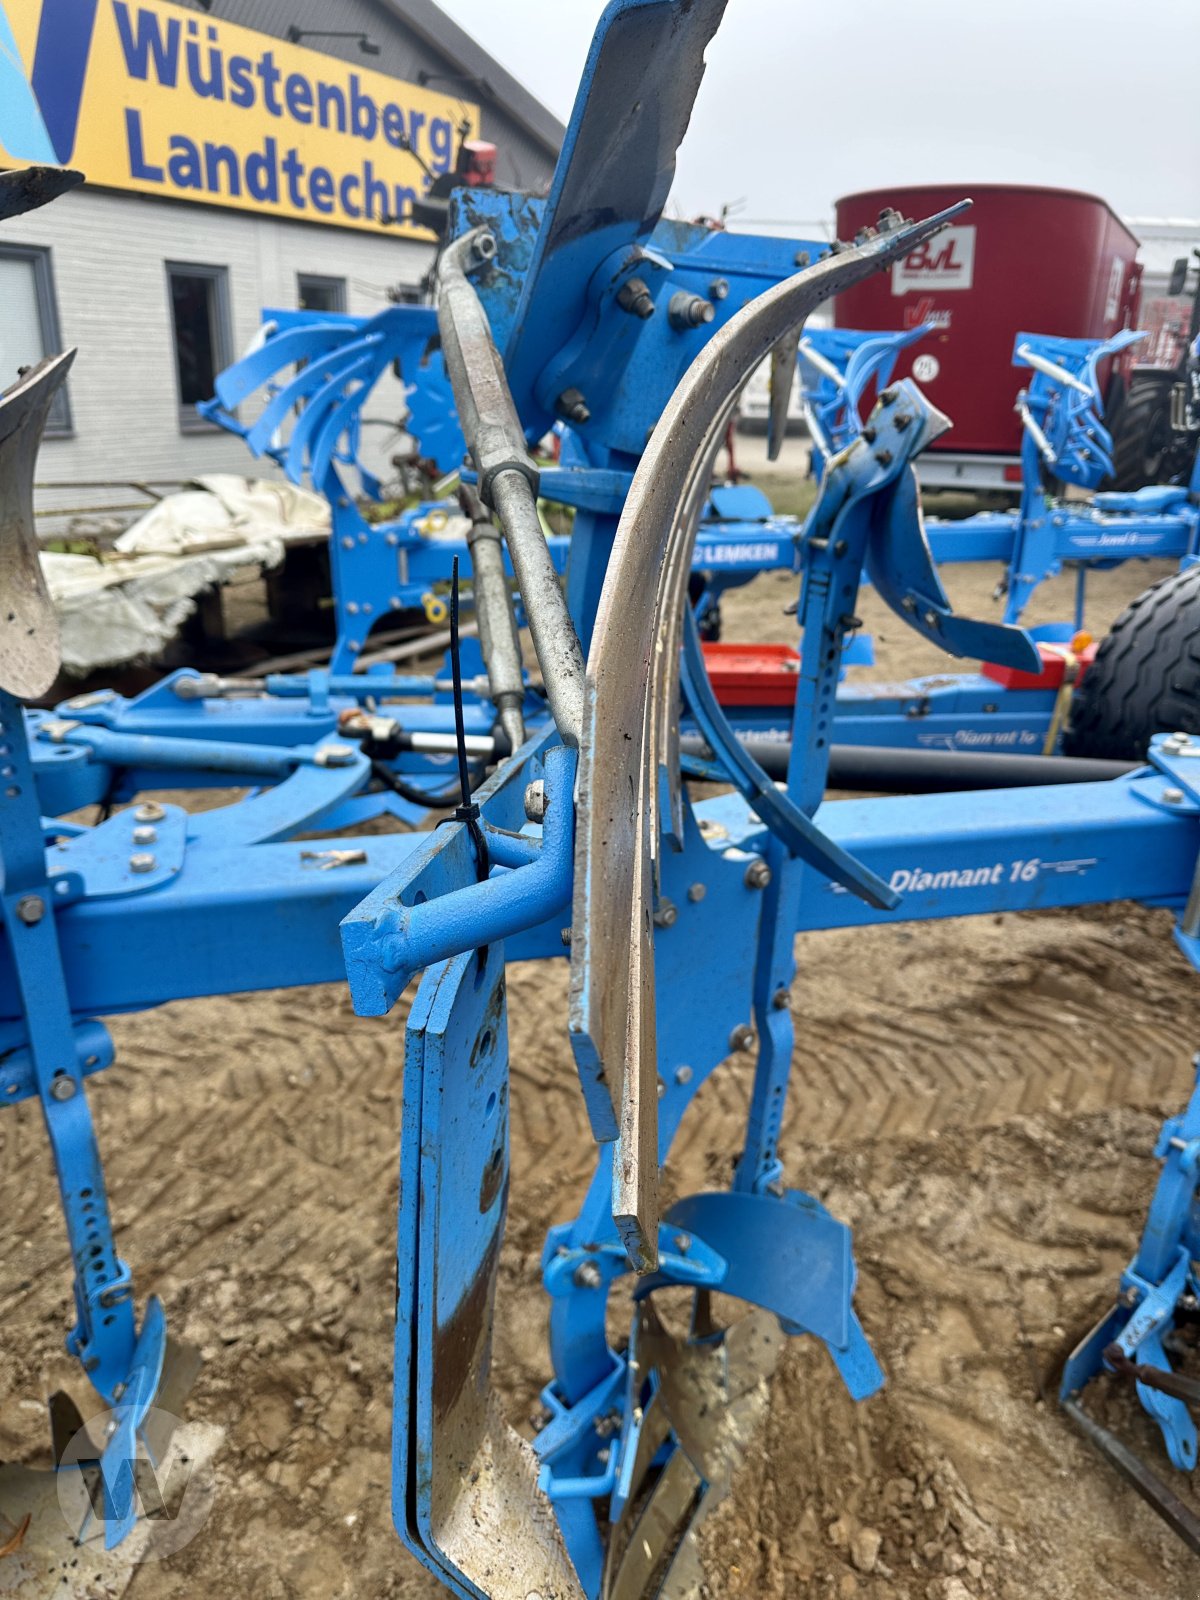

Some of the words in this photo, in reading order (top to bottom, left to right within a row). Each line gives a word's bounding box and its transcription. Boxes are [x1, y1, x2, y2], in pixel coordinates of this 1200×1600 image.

[113, 1, 453, 173] Wüstenberg
[125, 108, 432, 228] Landtechn
[704, 543, 779, 563] LEMKEN
[889, 864, 1004, 893] Diamant
[1009, 857, 1042, 881] 16
